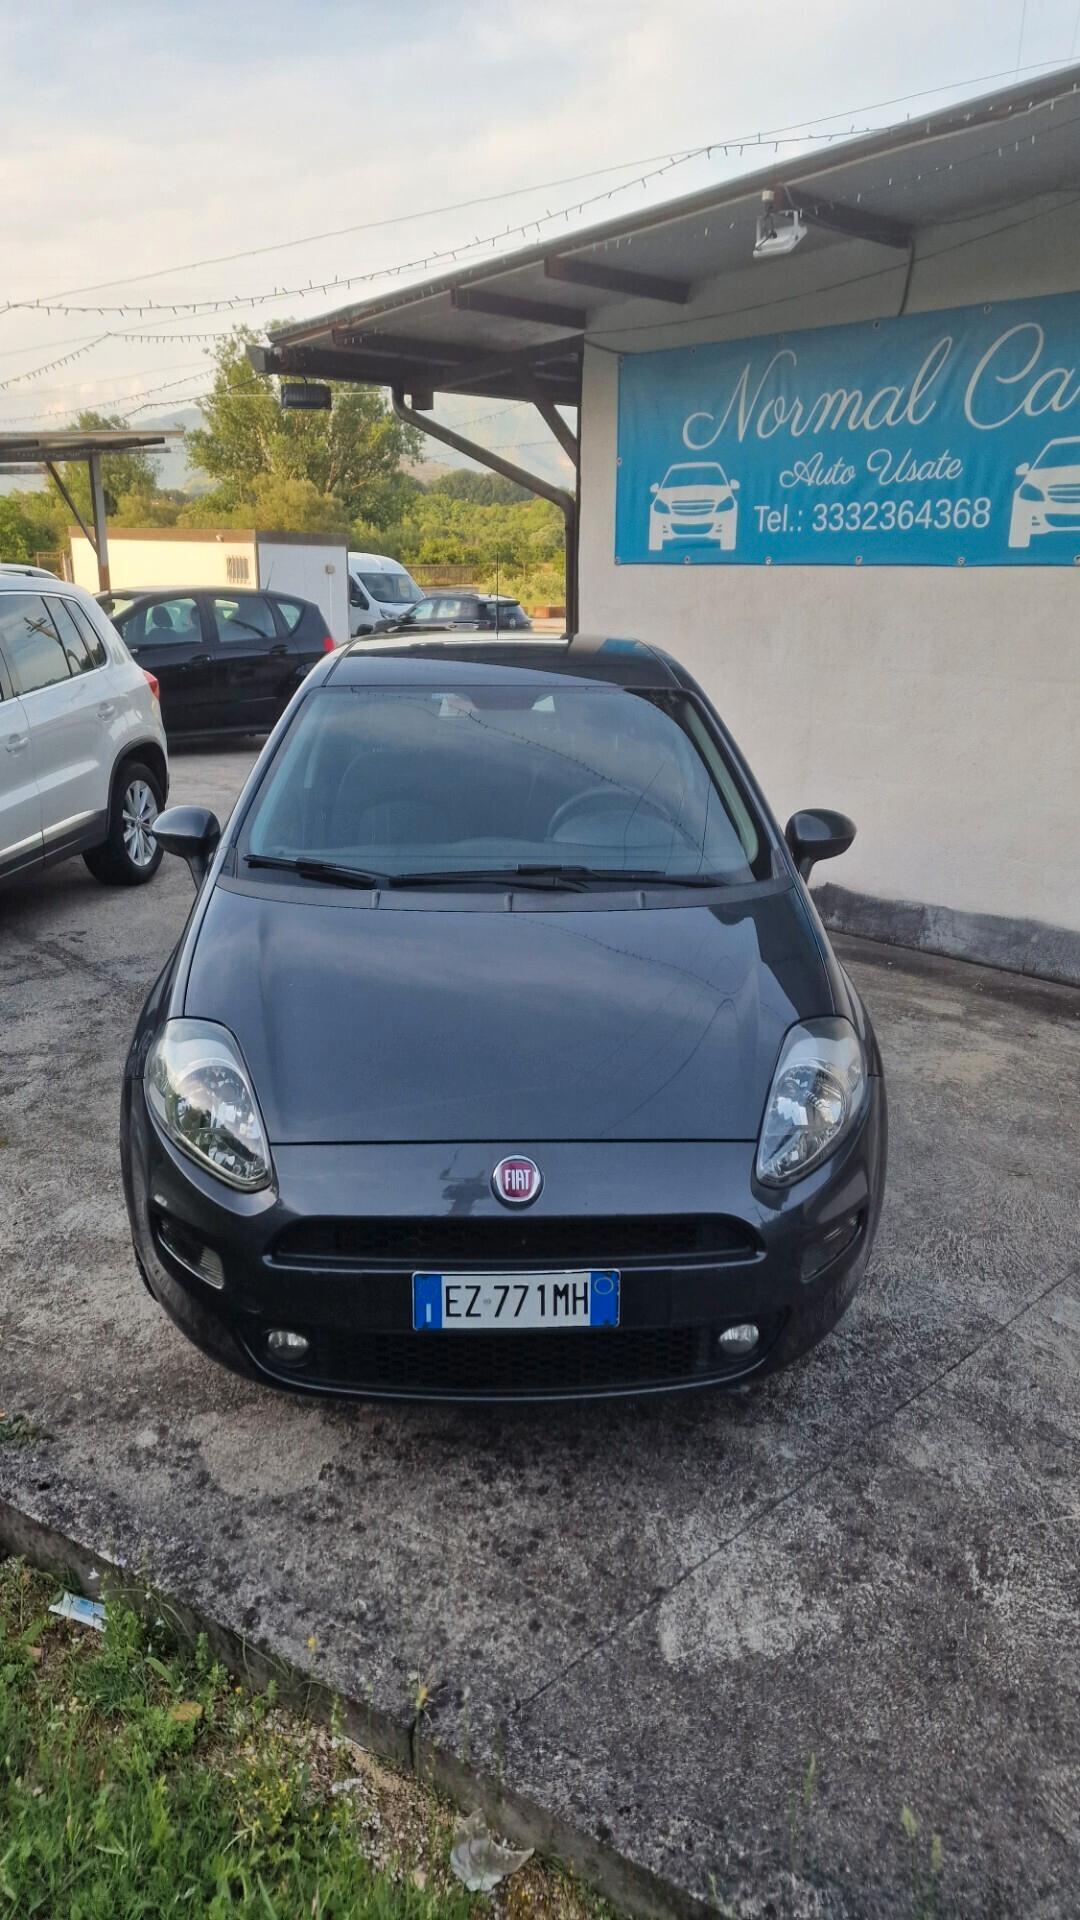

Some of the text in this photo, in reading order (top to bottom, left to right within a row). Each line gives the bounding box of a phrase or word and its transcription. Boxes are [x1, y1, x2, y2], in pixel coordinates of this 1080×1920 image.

[682, 322, 1080, 450] Normal Ca
[779, 448, 964, 488] Auto Usate
[753, 497, 992, 533] Tel.: 3332364368
[504, 1169, 531, 1190] FIAT
